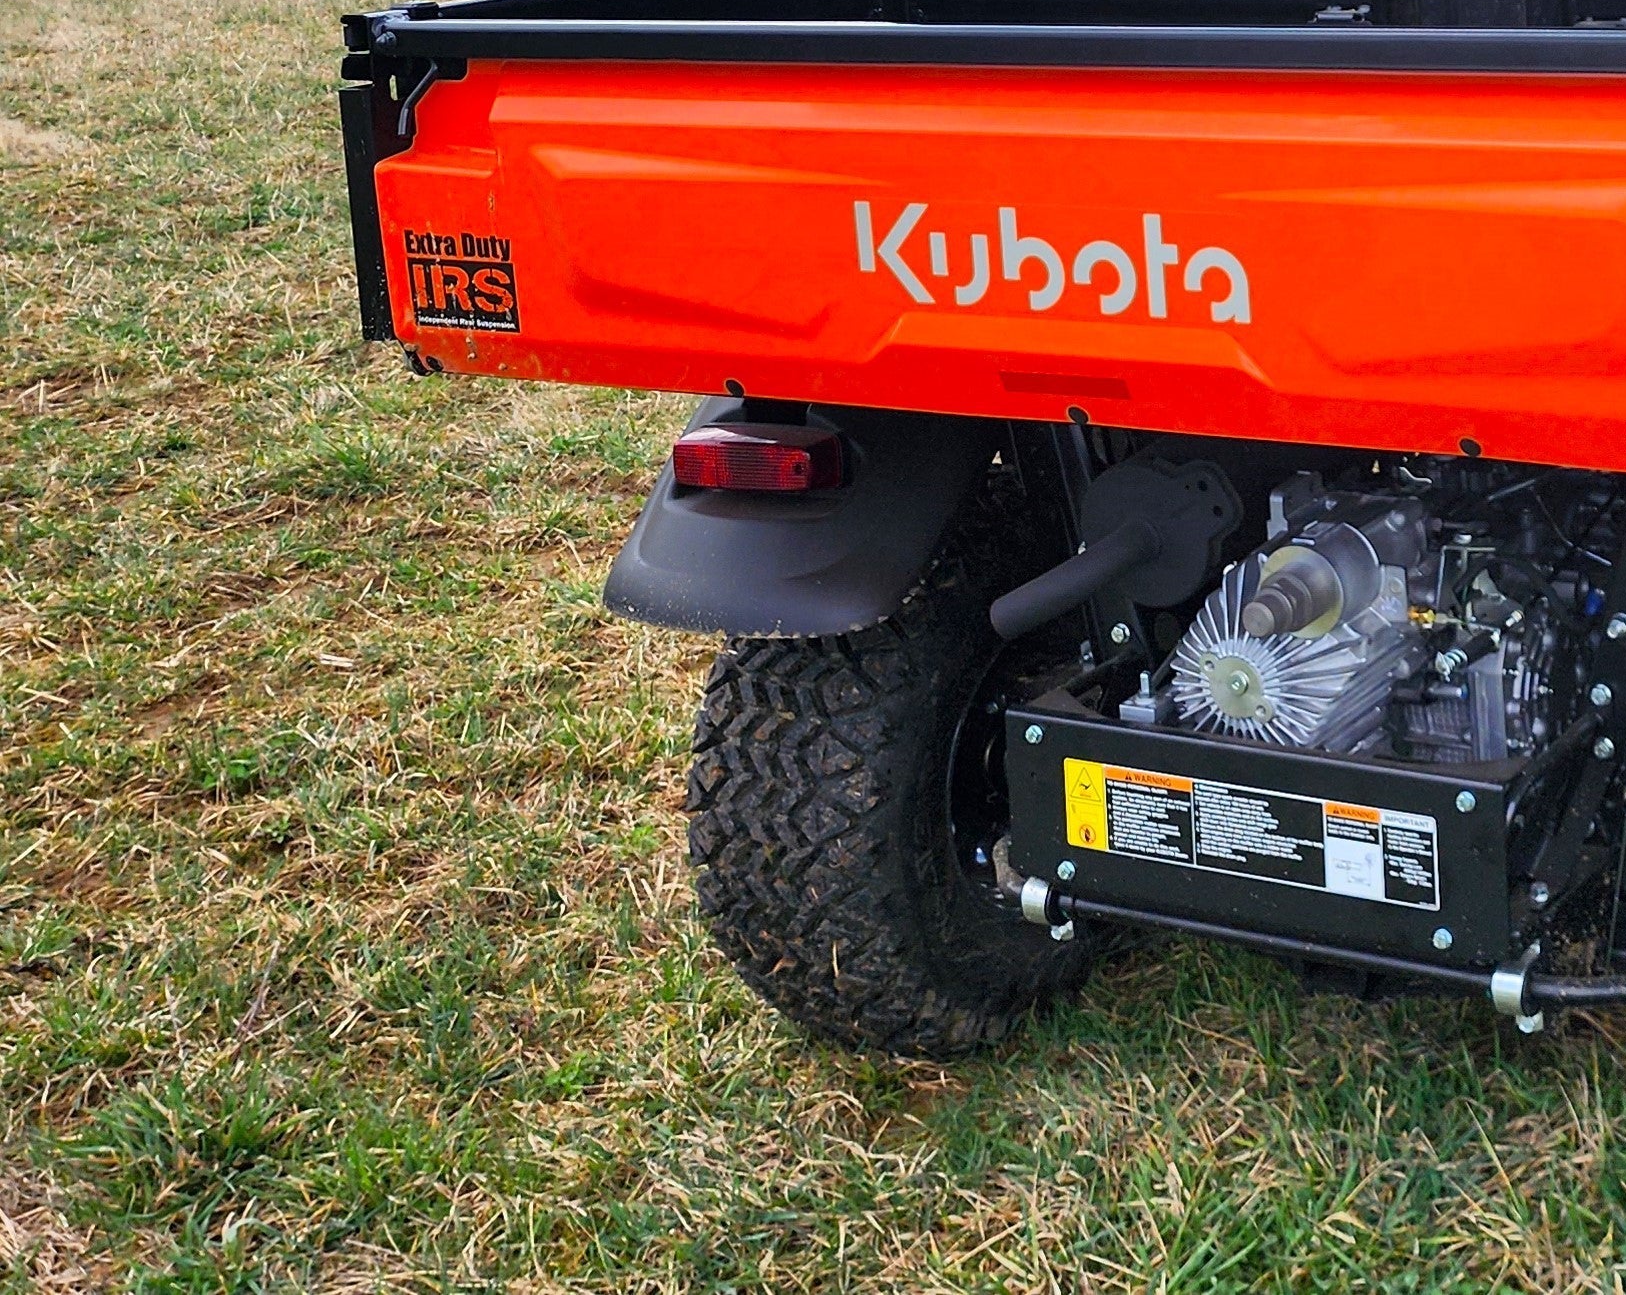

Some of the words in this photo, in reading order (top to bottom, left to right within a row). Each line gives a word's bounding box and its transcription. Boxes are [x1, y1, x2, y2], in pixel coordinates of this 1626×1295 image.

[404, 229, 457, 256] Extra
[461, 232, 511, 262] Duty
[853, 201, 1252, 324] Kubota
[412, 264, 514, 313] IRS
[1133, 773, 1172, 787] WARNING
[1339, 808, 1376, 820] WARNING
[1384, 814, 1430, 828] IMPORTANT
